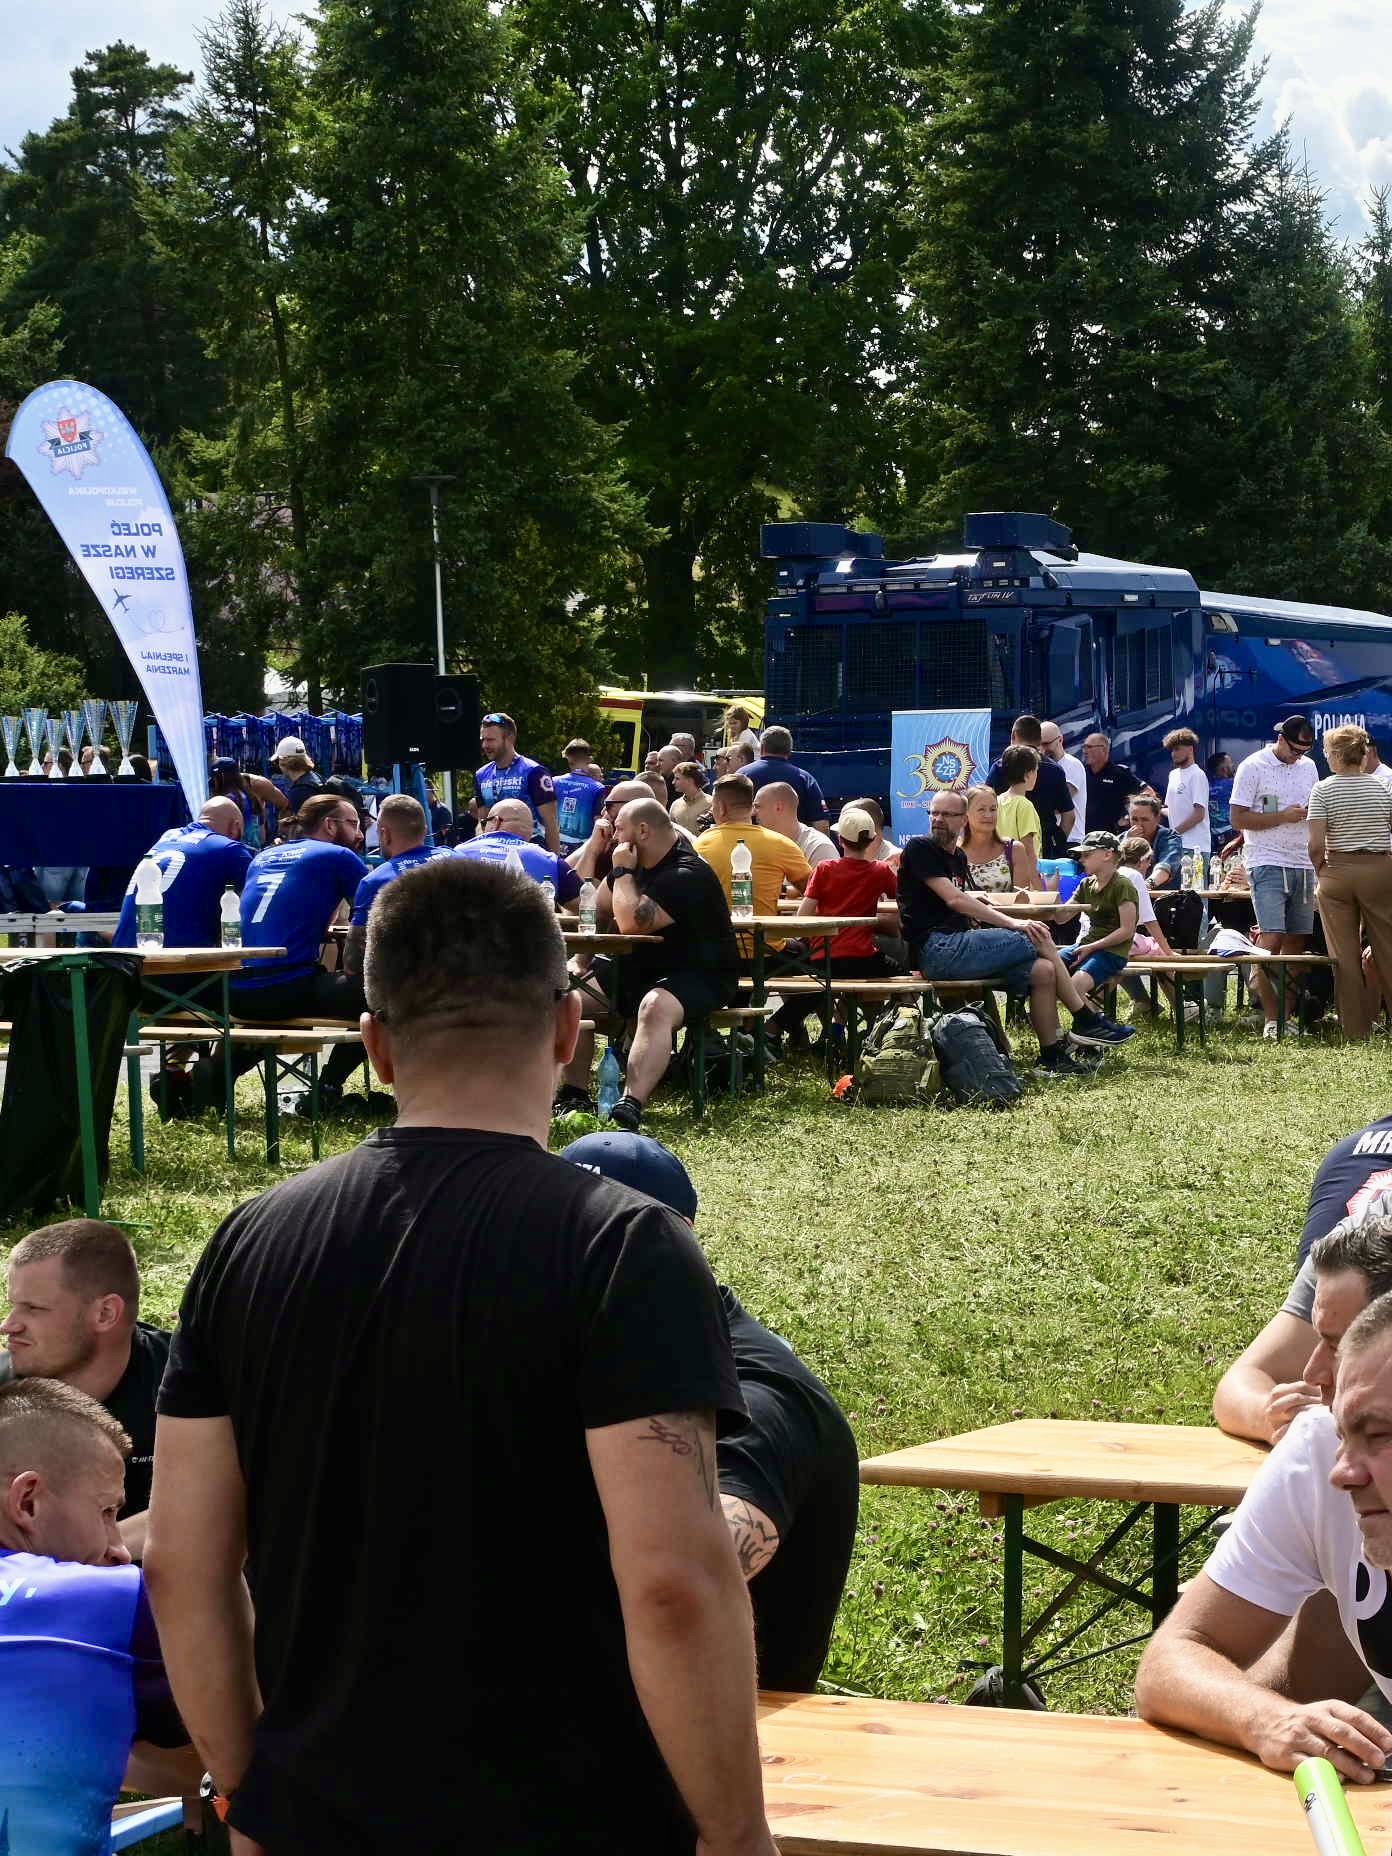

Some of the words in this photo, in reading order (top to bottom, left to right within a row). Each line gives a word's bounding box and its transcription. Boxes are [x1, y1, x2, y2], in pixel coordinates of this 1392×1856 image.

[942, 755, 957, 768] NS
[936, 763, 957, 778] ZZP
[252, 871, 288, 924] 7
